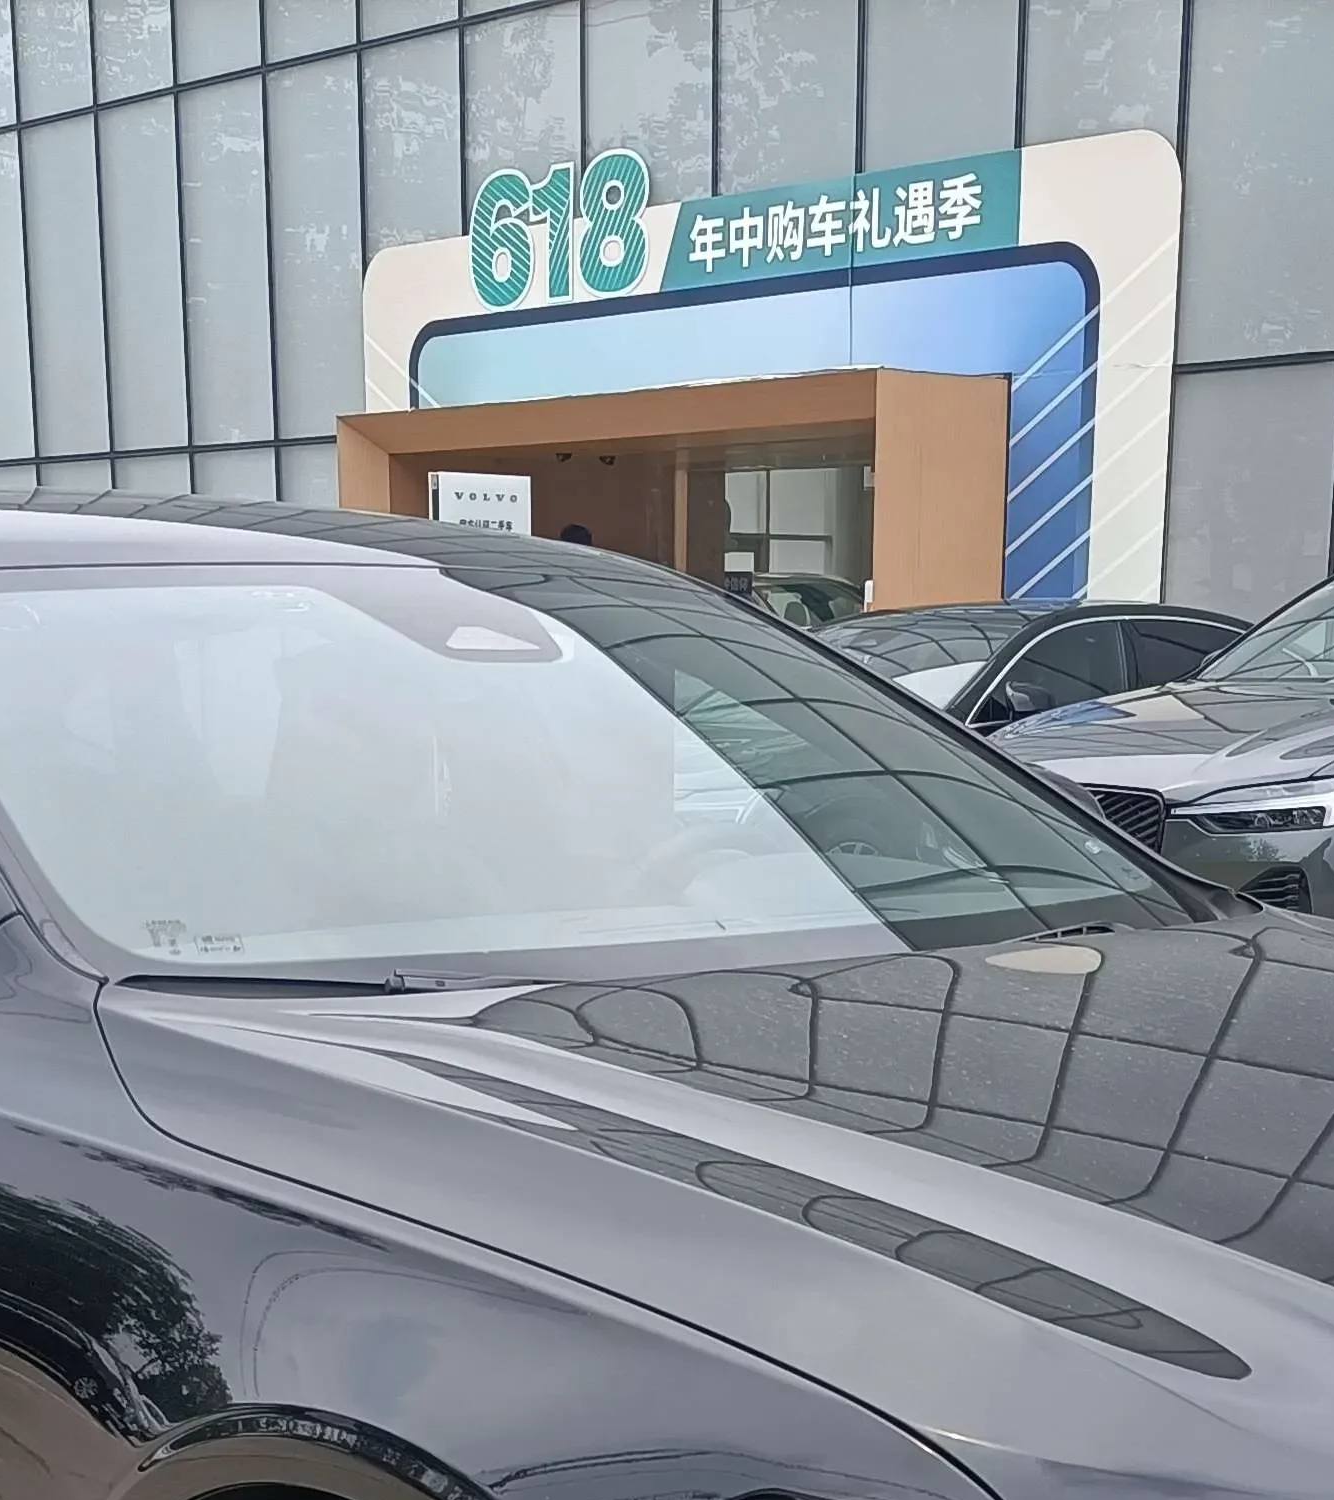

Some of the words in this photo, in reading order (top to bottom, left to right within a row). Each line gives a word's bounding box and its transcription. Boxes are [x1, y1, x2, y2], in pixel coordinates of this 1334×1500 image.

[468, 147, 652, 313] 618
[688, 172, 984, 273] 年中购车礼遇季
[455, 491, 518, 503] VOLVO
